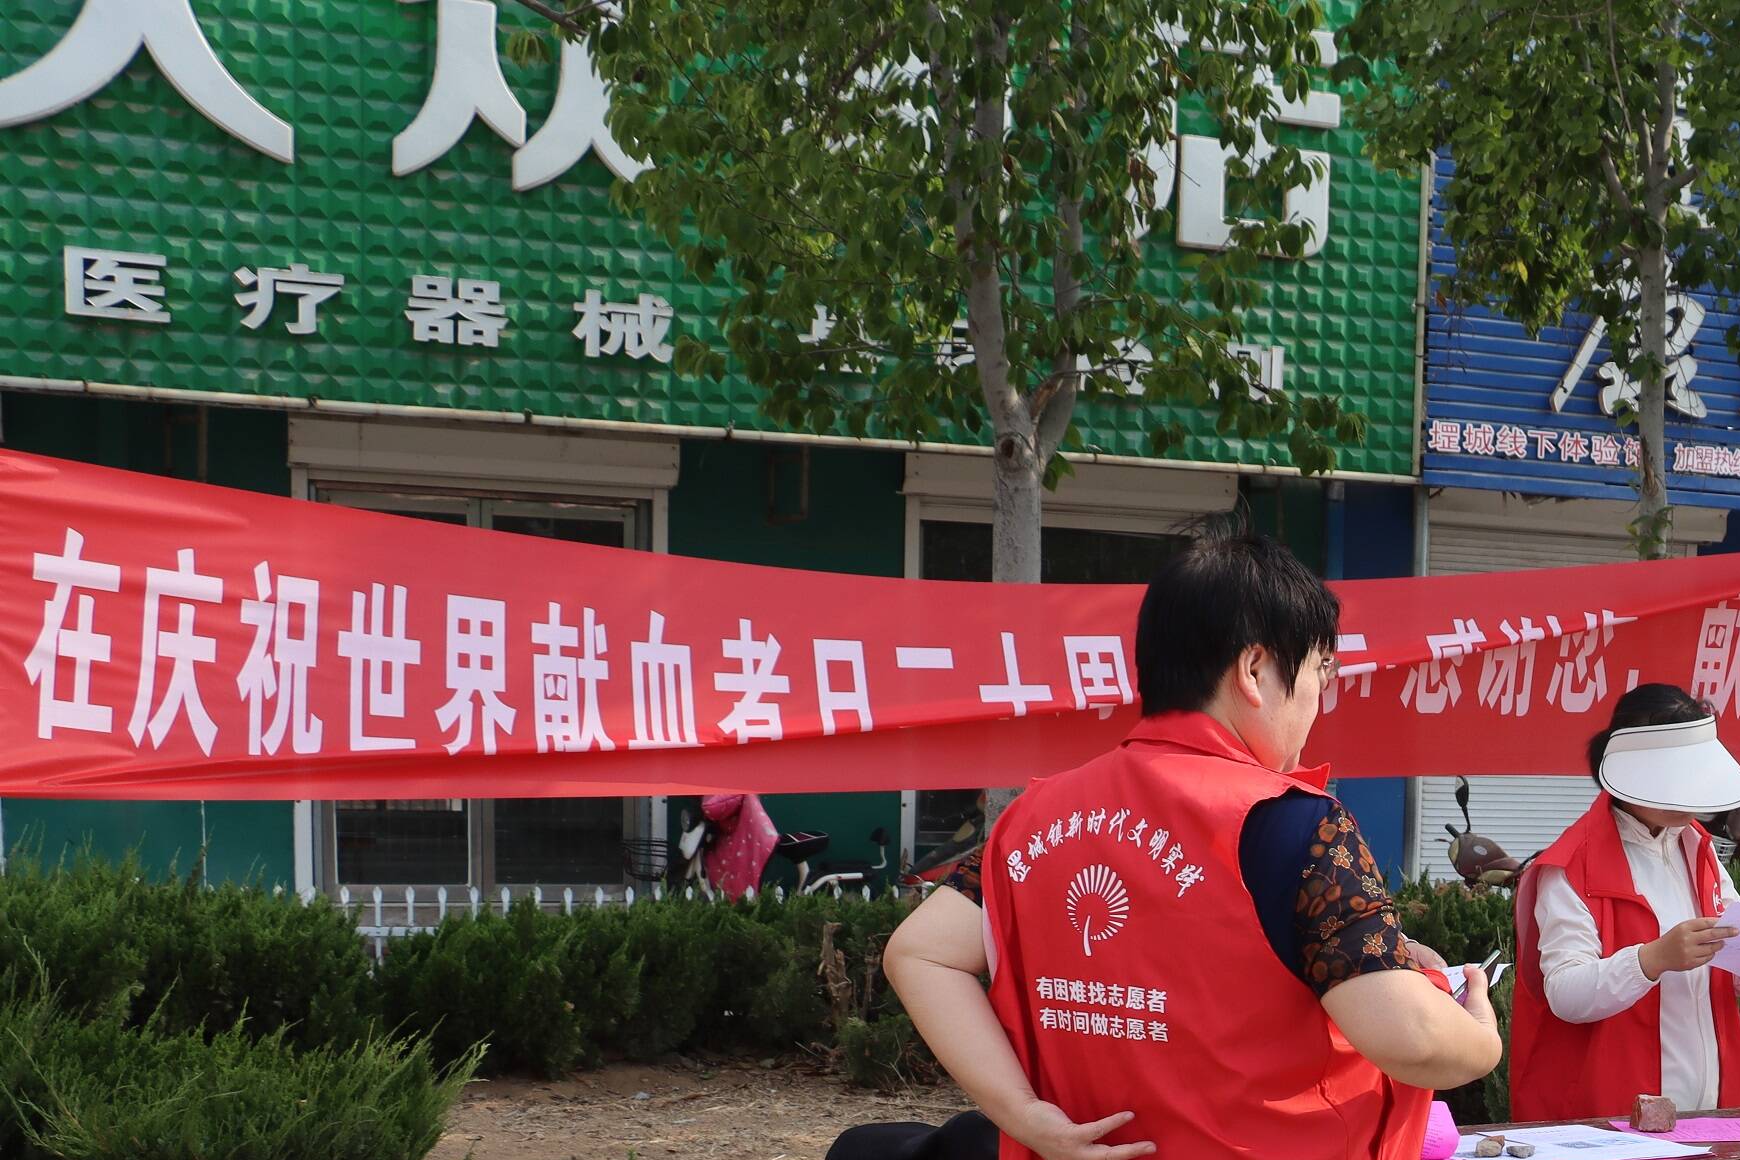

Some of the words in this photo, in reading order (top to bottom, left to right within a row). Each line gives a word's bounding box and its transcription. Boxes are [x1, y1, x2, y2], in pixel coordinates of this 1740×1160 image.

[1036, 976, 1168, 1014] 有困难找志愿者
[1039, 1007, 1169, 1043] 有时间做志愿者
